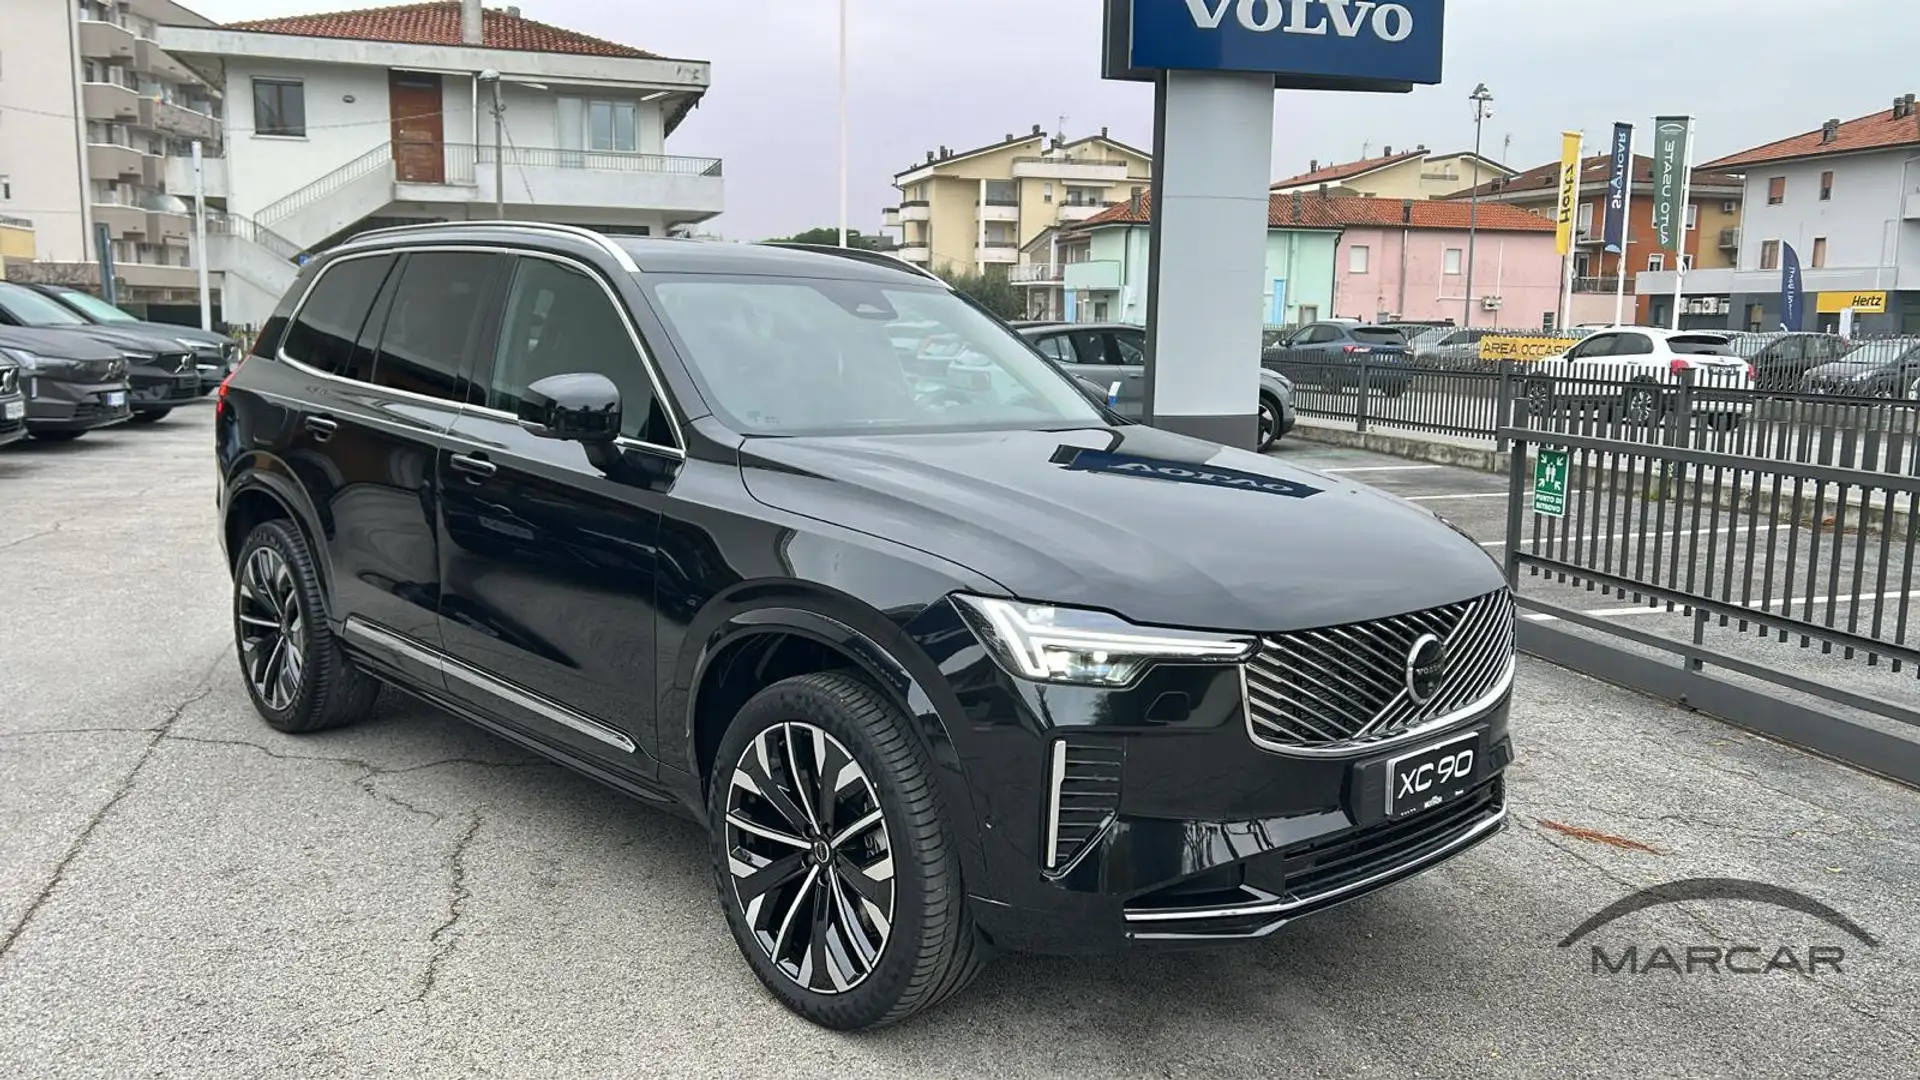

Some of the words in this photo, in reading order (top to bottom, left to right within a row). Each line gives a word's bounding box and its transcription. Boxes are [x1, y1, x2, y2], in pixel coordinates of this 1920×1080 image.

[1184, 0, 1413, 41] VOLVO
[1851, 295, 1882, 307] Hertz
[1483, 342, 1517, 354] AREA
[1536, 493, 1554, 503] PUNTO
